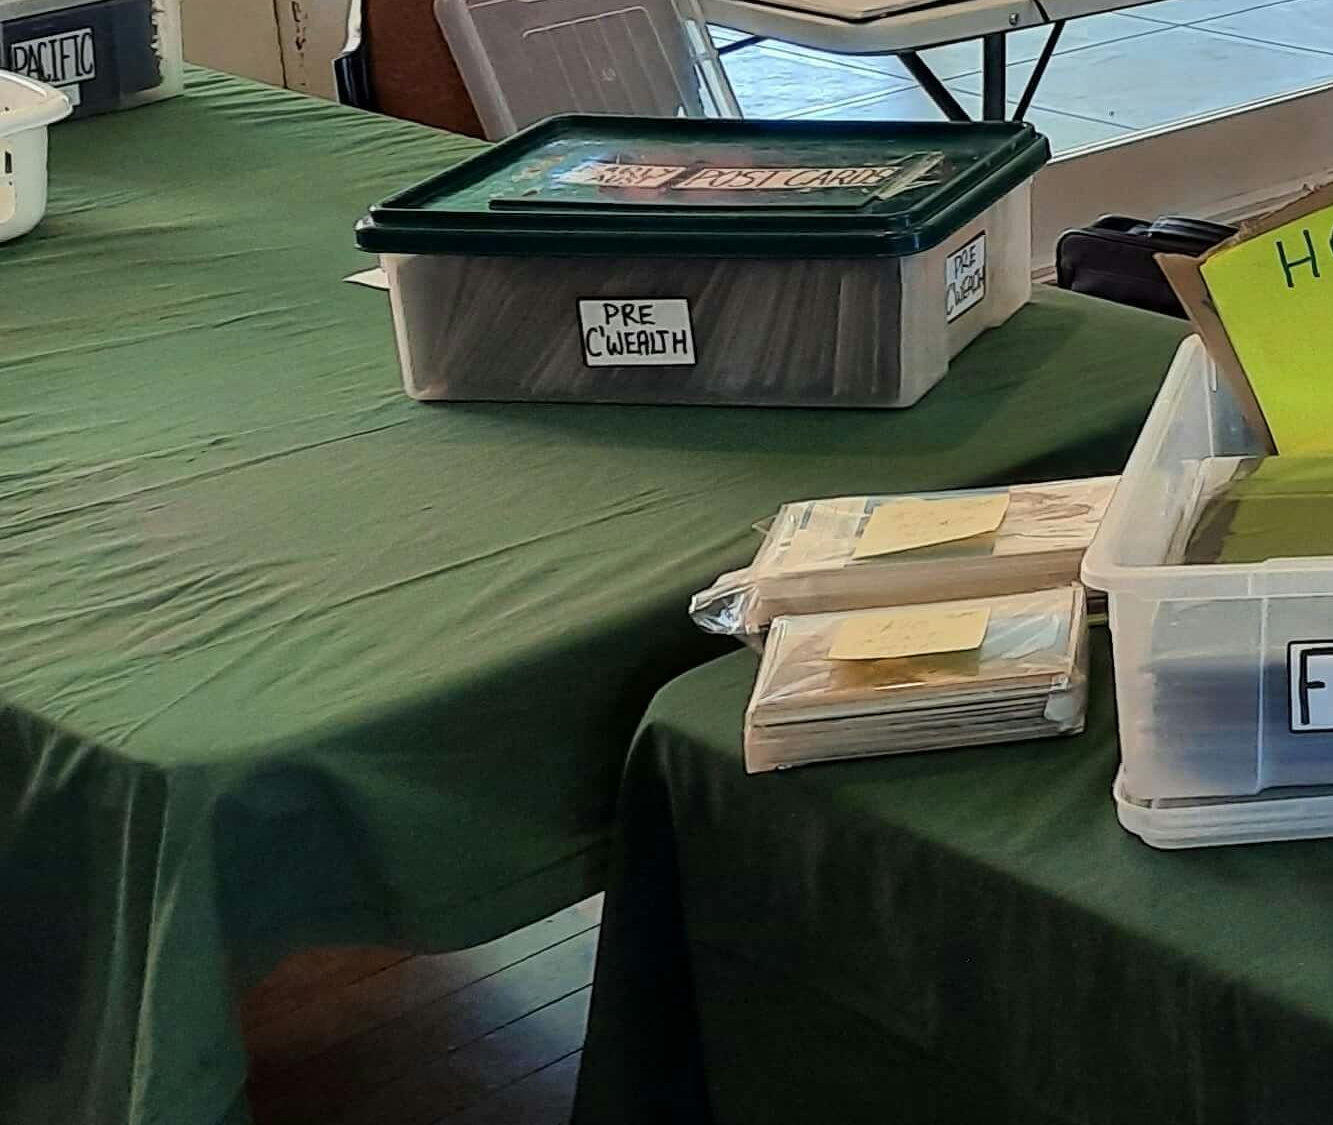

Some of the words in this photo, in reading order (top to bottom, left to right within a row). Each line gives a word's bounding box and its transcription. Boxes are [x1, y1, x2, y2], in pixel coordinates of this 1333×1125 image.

[13, 31, 94, 82] PACIFIC
[686, 167, 787, 187] POST
[603, 303, 656, 326] PRE
[586, 325, 688, 357] C'WEALTH
